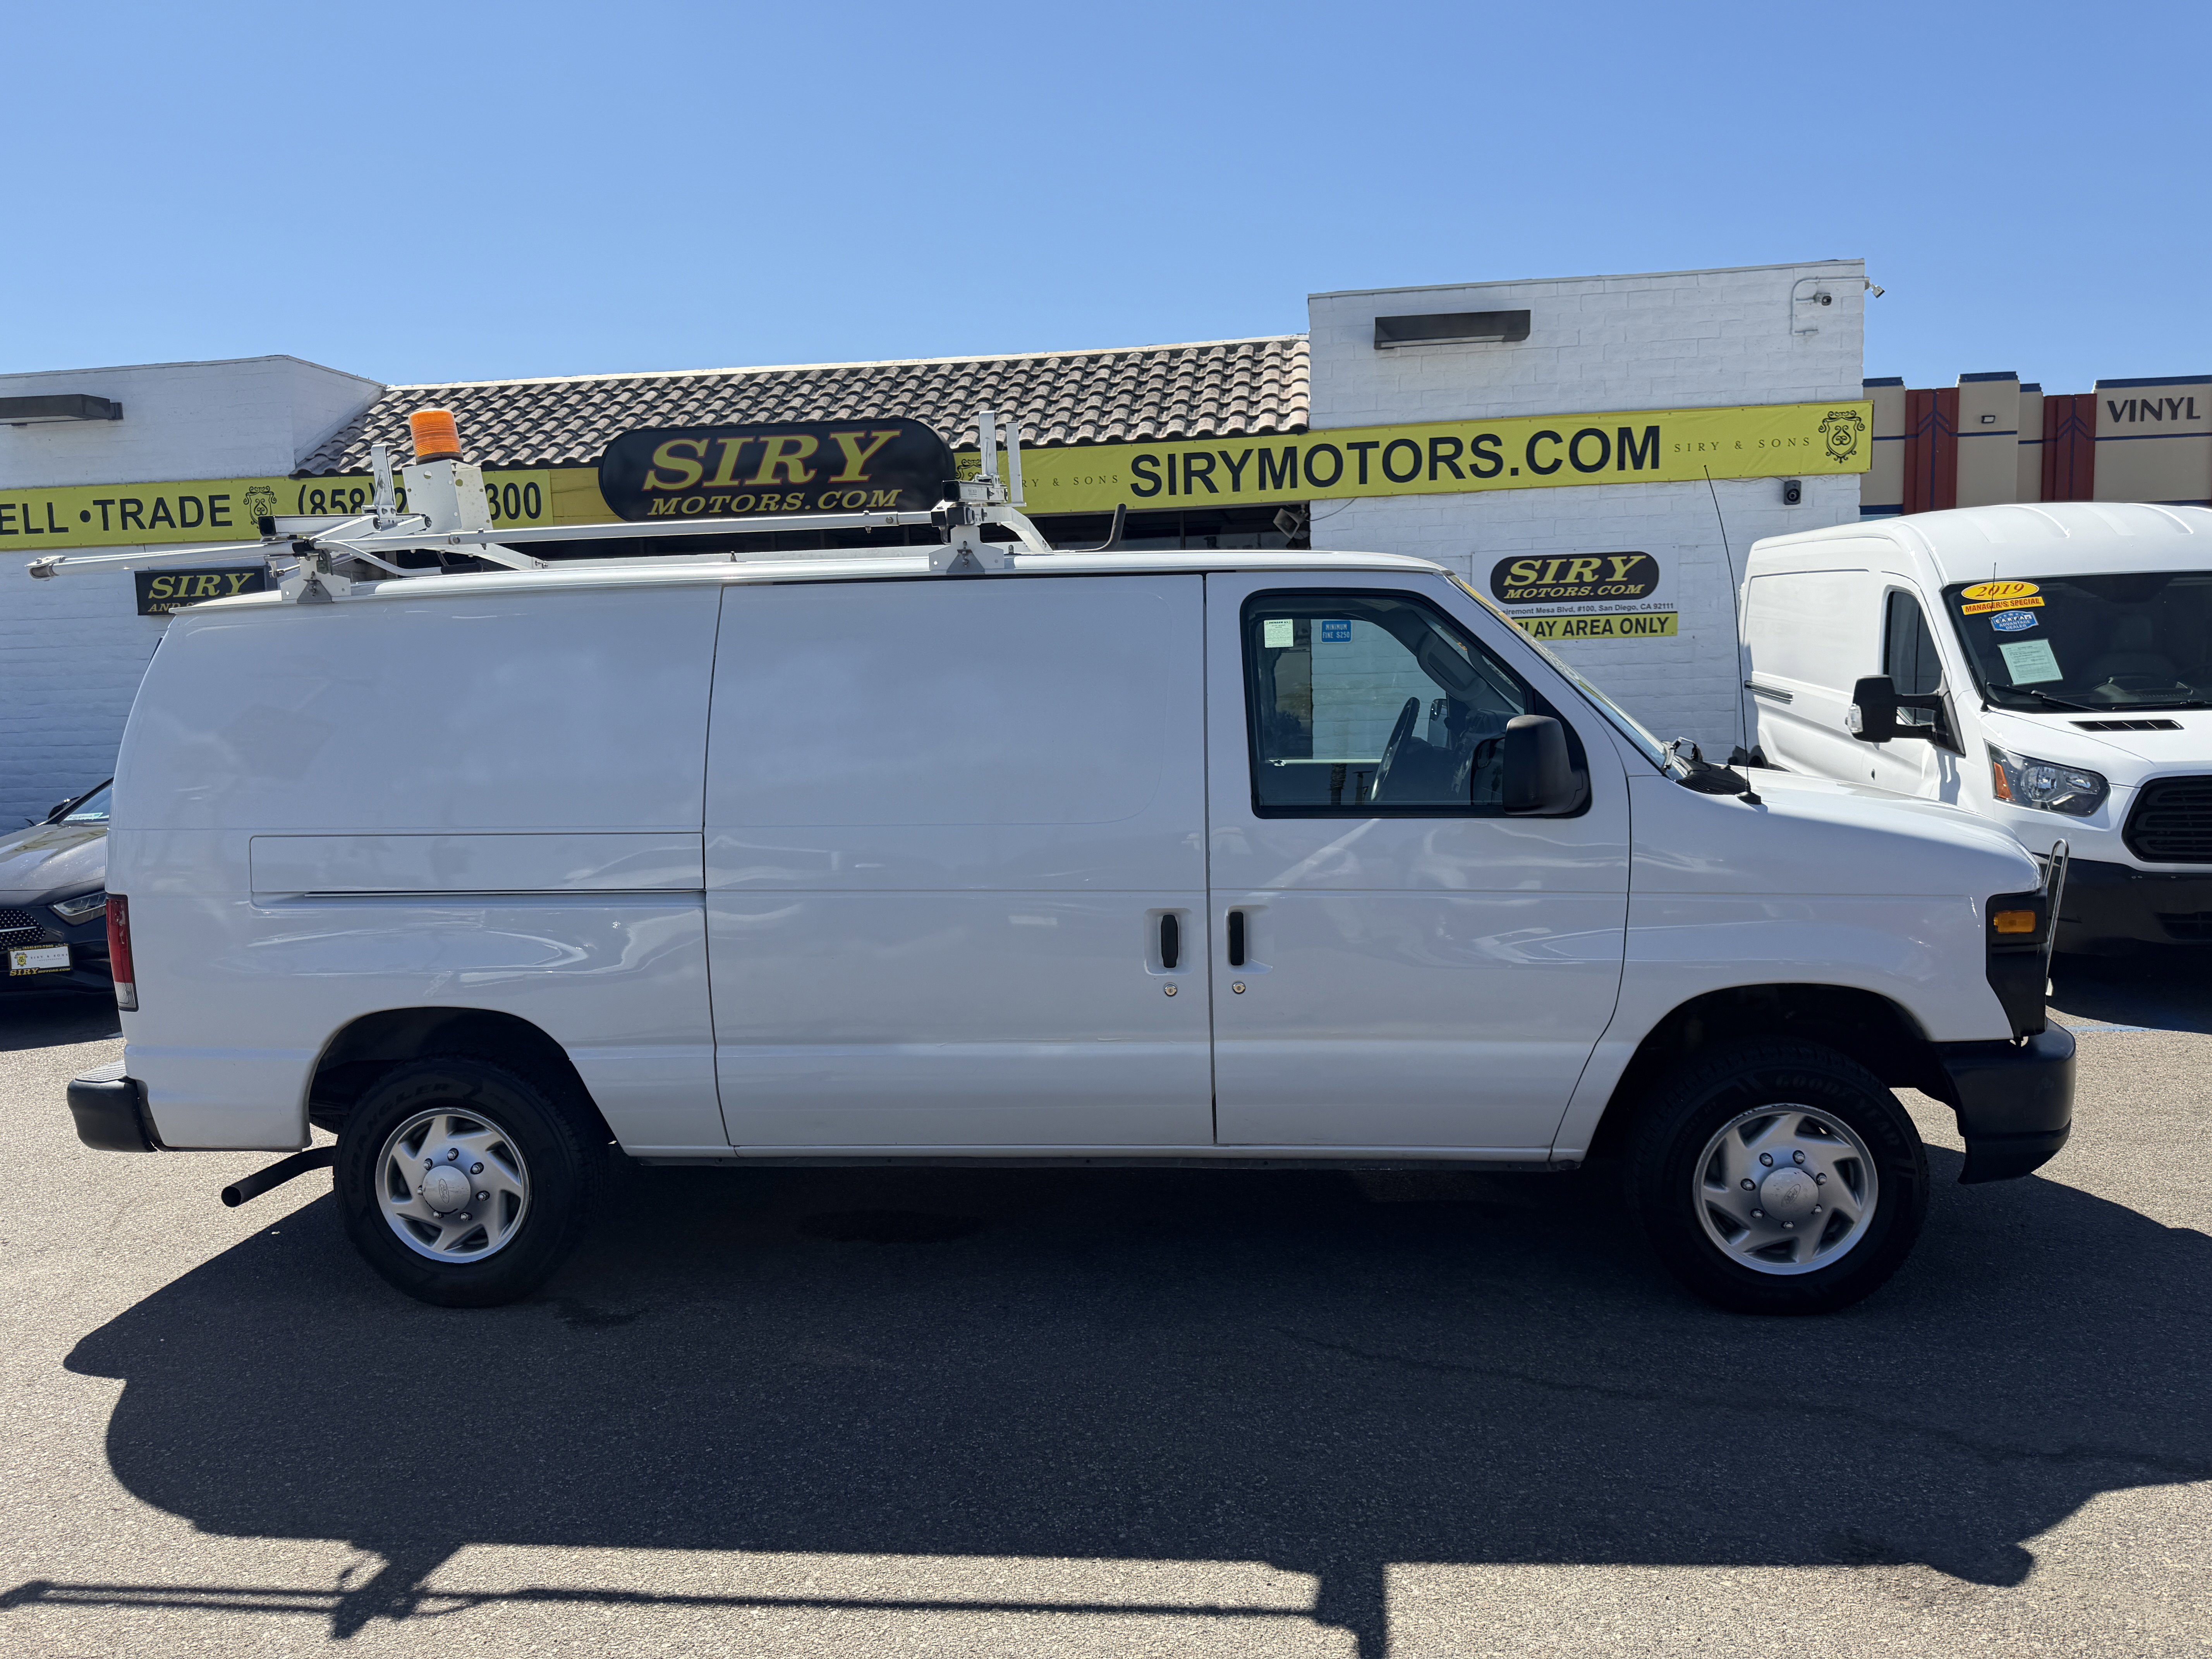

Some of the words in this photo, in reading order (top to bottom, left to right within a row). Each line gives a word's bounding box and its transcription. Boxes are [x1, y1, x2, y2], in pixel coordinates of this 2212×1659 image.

[2107, 397, 2200, 423] VINYL
[1674, 441, 1720, 452] SIRY
[1734, 440, 1743, 450] &
[1758, 437, 1810, 448] SONS
[641, 429, 902, 491] SIRY
[1130, 425, 1660, 497] SIRYMOTORS.COM
[1053, 478, 1060, 486] &
[1073, 474, 1118, 486] SONS
[93, 495, 232, 531] TRADE
[647, 489, 902, 516] MOTORS.COM
[1503, 555, 1647, 586] SIRY
[148, 573, 255, 599] SIRY
[1503, 584, 1645, 599] MOTORS.COM
[1975, 583, 2025, 597] 2019
[1557, 605, 1575, 613] Blvd,
[1615, 603, 1638, 612] Diego,
[1965, 601, 2009, 612] MANAGER'S
[2010, 598, 2041, 607] SPECIAL
[1562, 619, 1614, 636] AREA
[1620, 617, 1669, 634] ONLY
